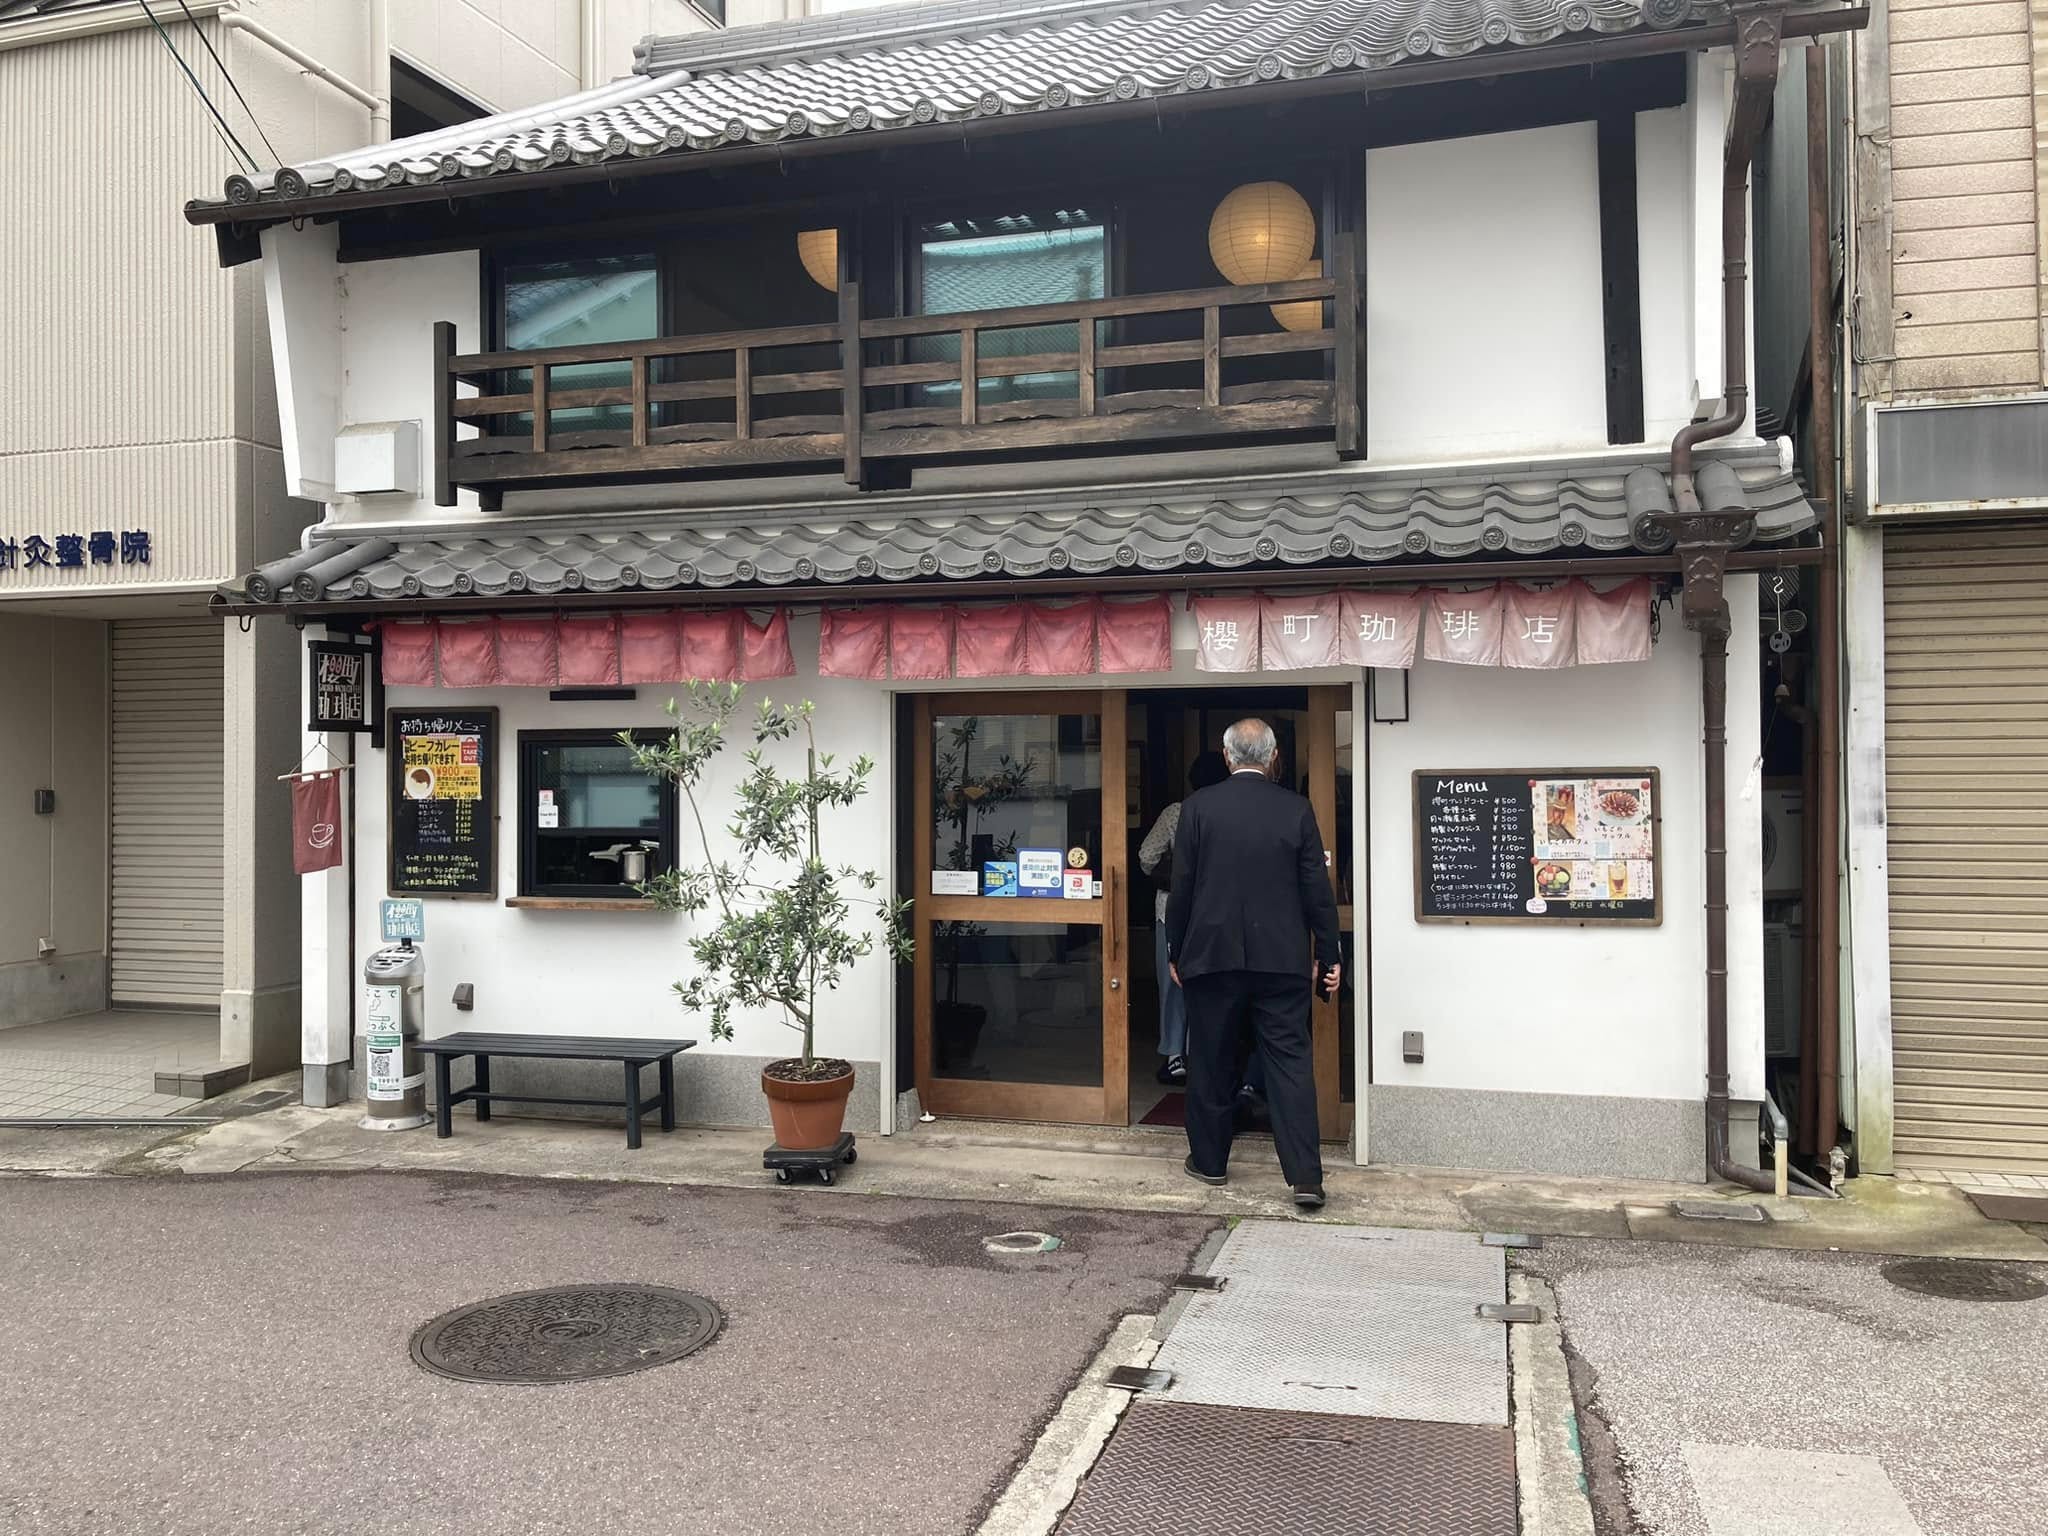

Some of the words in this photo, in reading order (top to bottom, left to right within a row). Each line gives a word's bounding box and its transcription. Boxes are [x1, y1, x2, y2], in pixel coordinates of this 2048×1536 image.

[401, 717, 486, 733] お持ち帰りメニュー
[410, 740, 460, 752] ビーフカレー
[1436, 779, 1489, 794] Menu
